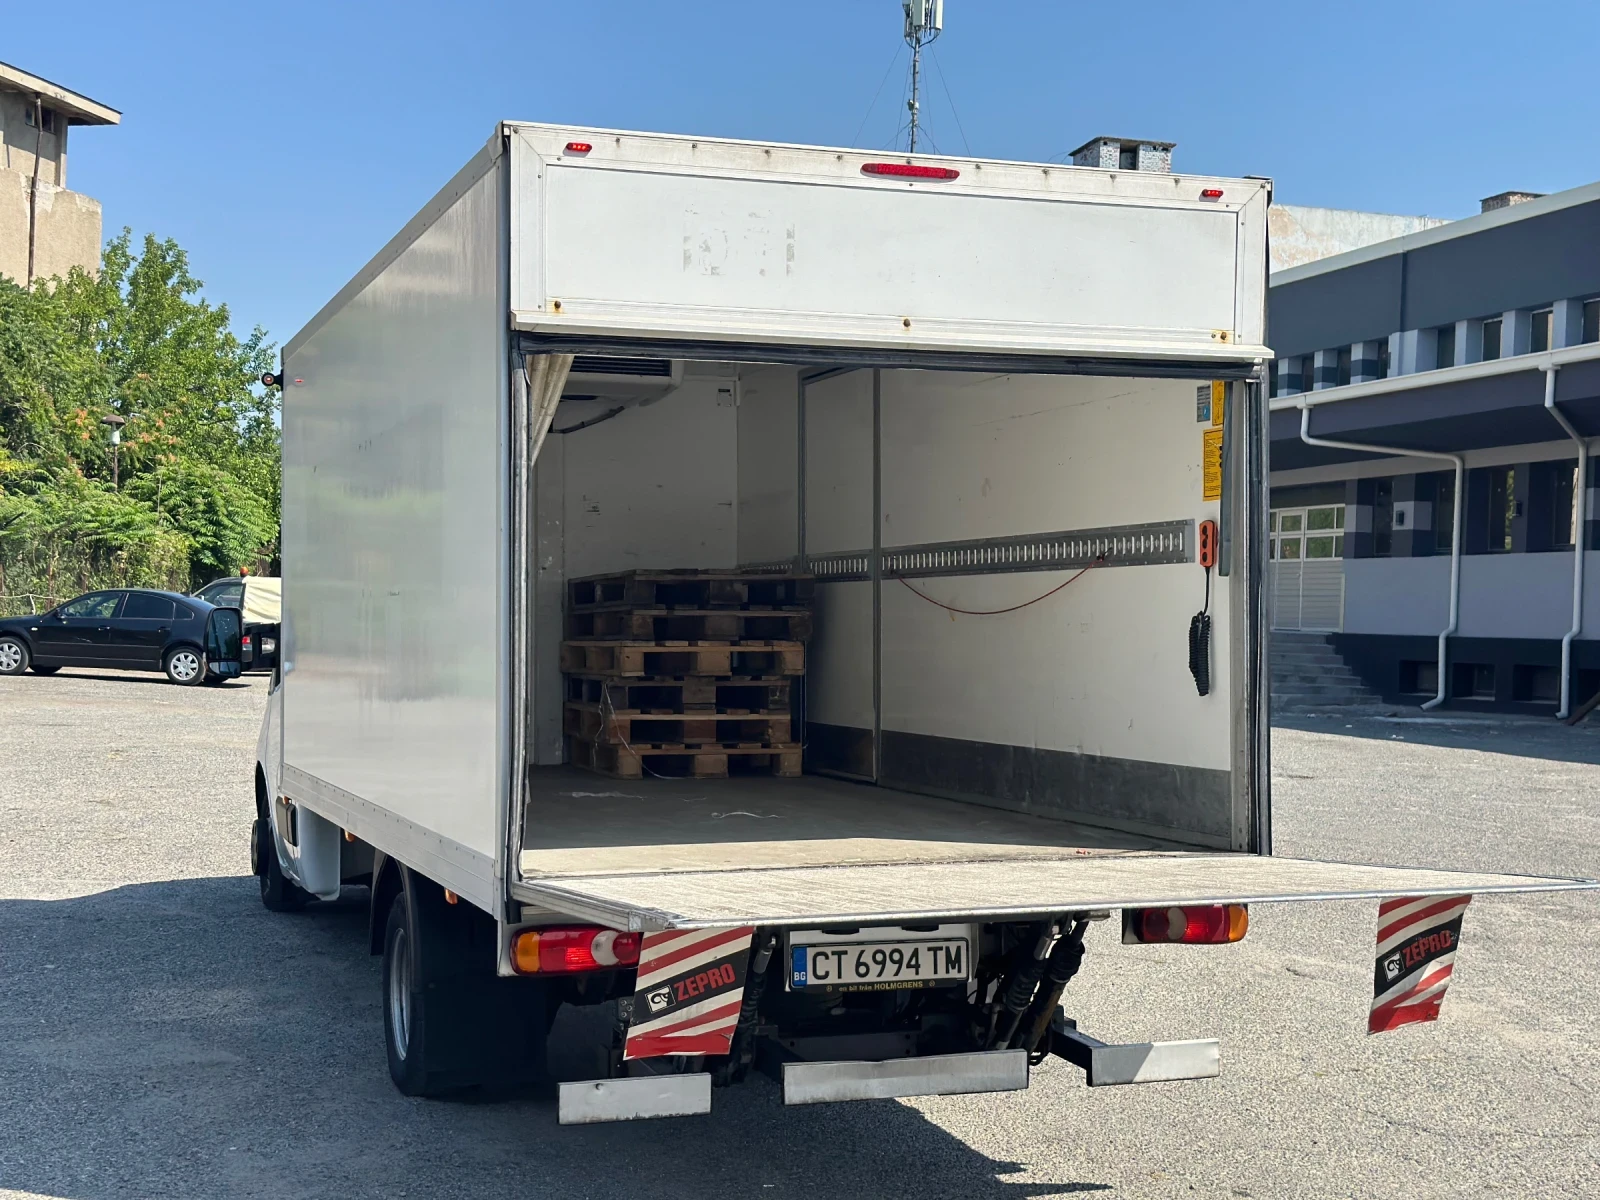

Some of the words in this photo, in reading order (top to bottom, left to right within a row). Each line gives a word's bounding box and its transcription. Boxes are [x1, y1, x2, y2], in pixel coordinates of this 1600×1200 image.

[812, 950, 848, 980] CT
[855, 947, 921, 978] 6994
[927, 945, 962, 974] TM
[1402, 930, 1453, 968] ZEPRO
[673, 963, 736, 1002] ZEPRO
[794, 971, 806, 981] BG
[874, 981, 924, 990] HOLMGRENS
